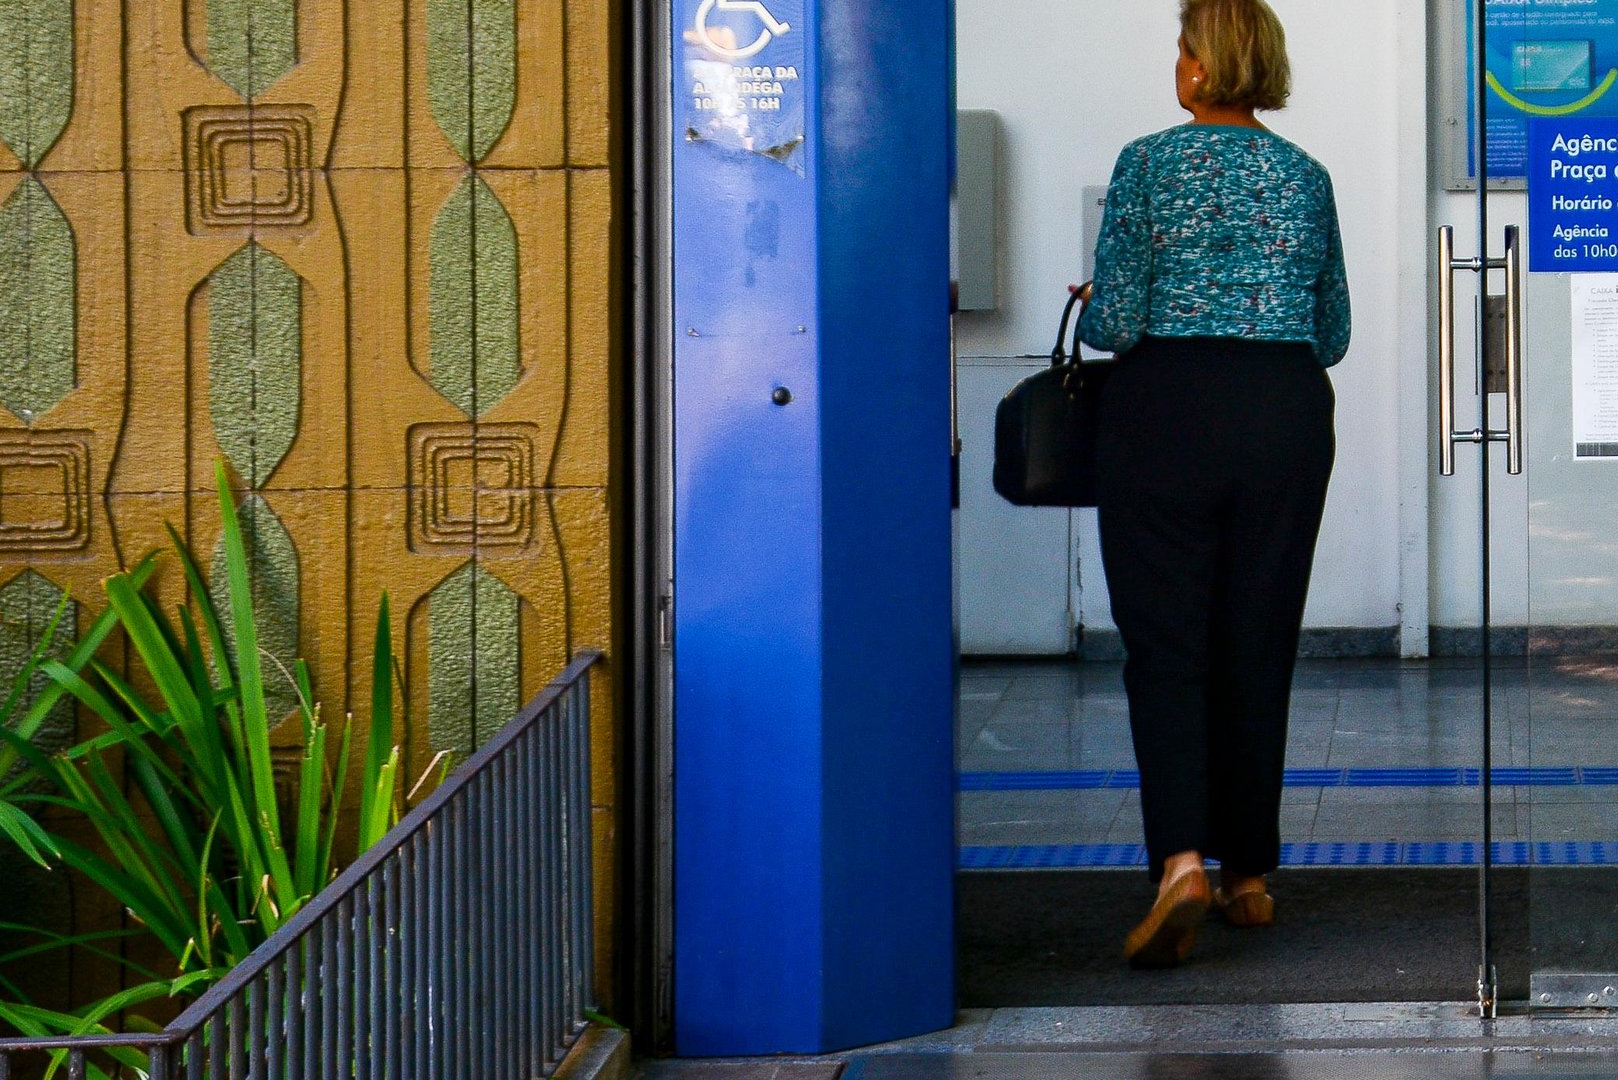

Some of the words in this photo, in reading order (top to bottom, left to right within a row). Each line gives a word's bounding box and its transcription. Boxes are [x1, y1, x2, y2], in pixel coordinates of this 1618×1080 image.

[726, 66, 773, 80] RAÇA
[775, 66, 798, 78] DA
[752, 98, 780, 109] 16H
[1551, 160, 1606, 182] Praça
[1553, 195, 1612, 210] Horário
[1553, 224, 1608, 241] Agência
[1554, 245, 1577, 257] das
